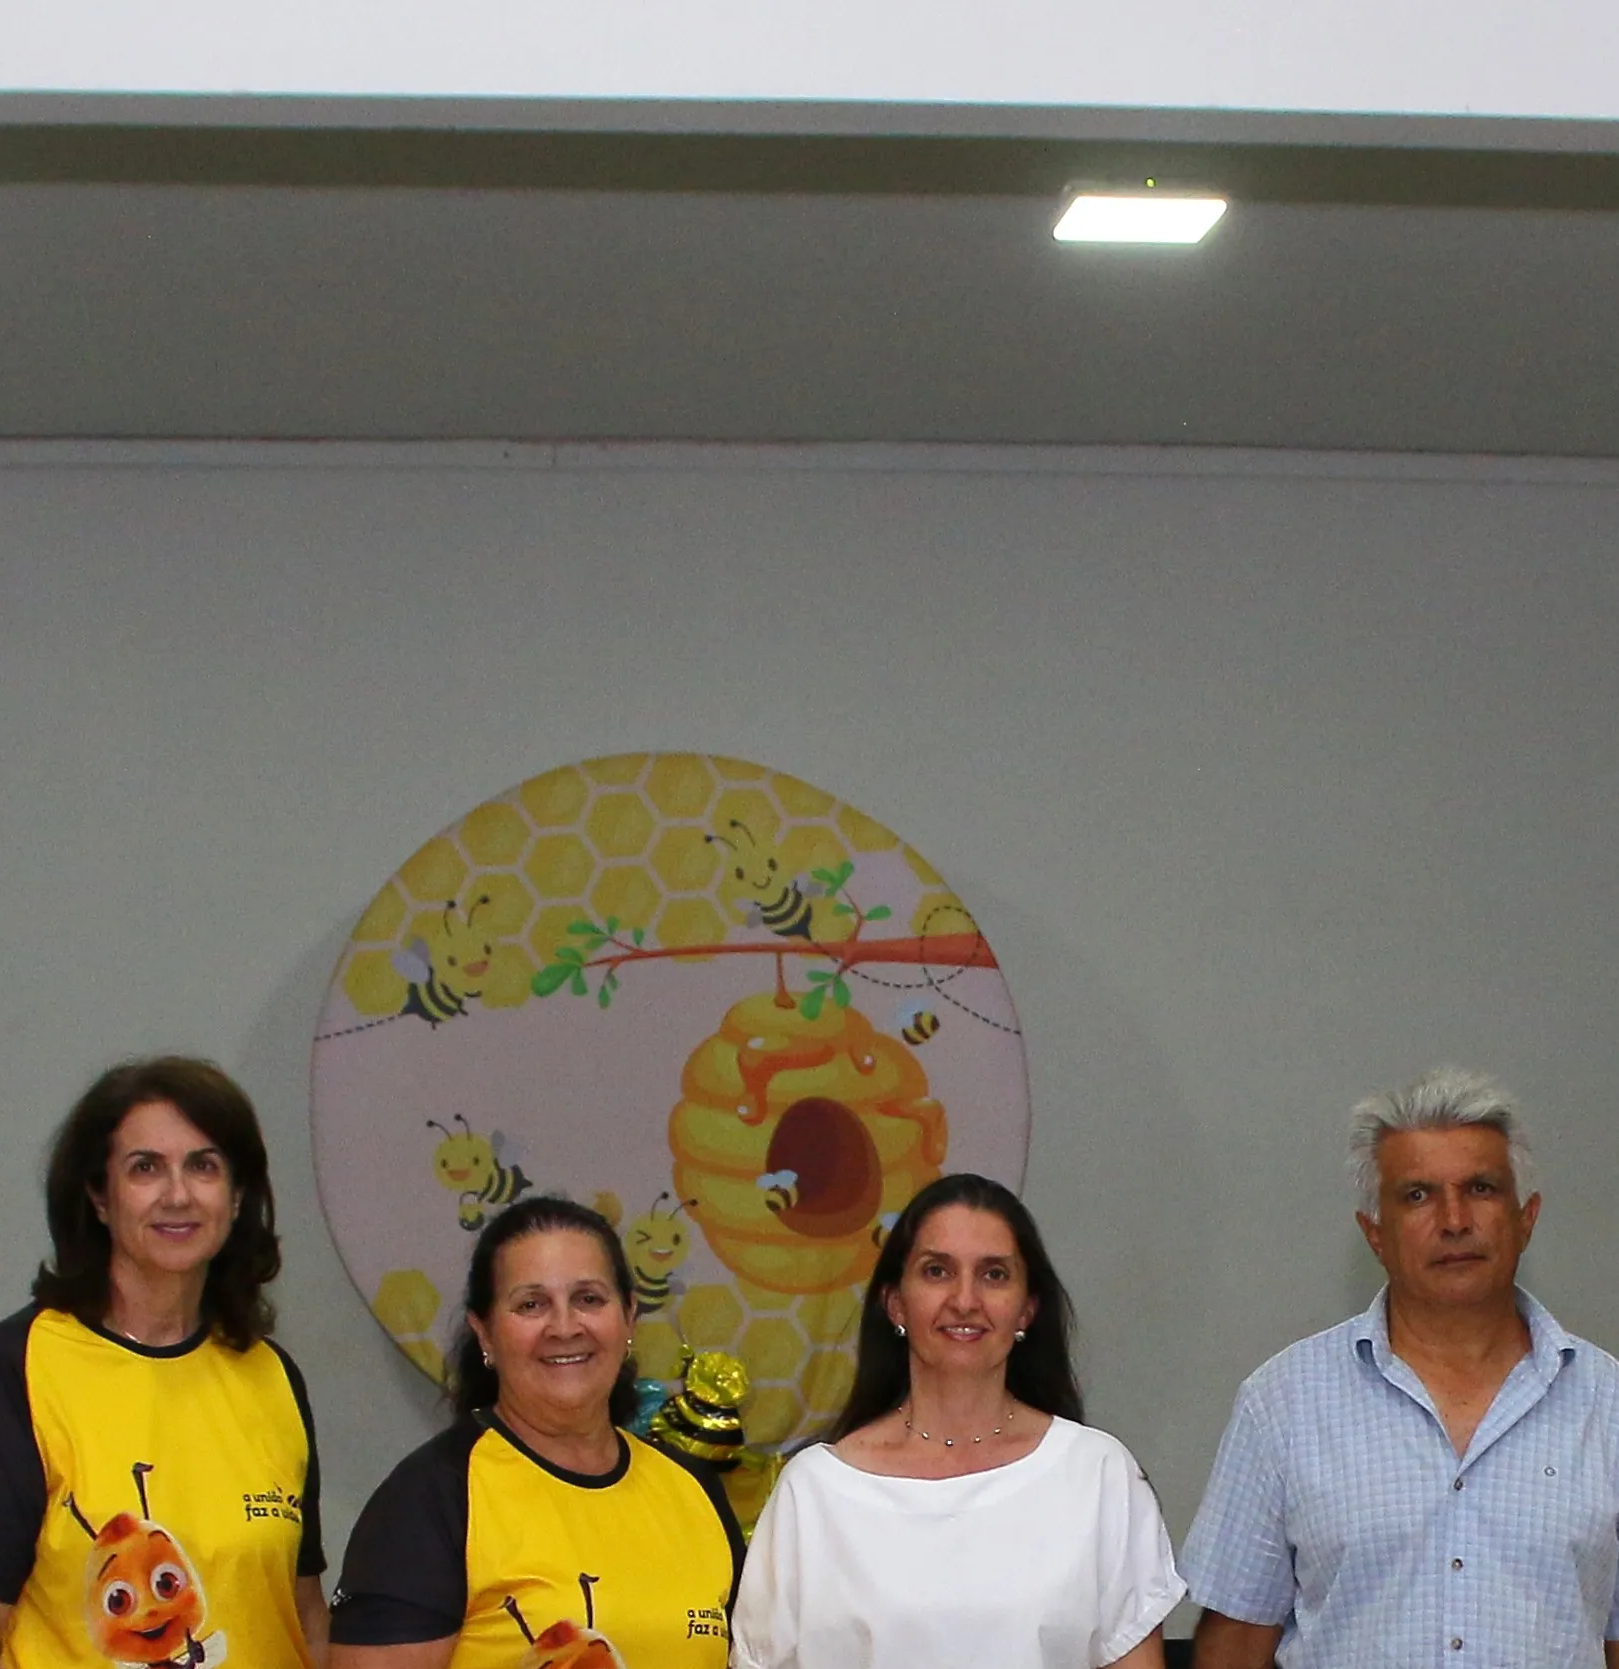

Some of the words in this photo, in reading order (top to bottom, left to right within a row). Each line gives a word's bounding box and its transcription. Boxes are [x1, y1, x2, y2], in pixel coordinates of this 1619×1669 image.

[243, 1494, 251, 1502] a
[246, 1504, 269, 1521] faz
[271, 1508, 279, 1517] a
[687, 1609, 695, 1618] a
[687, 1620, 710, 1639] faz
